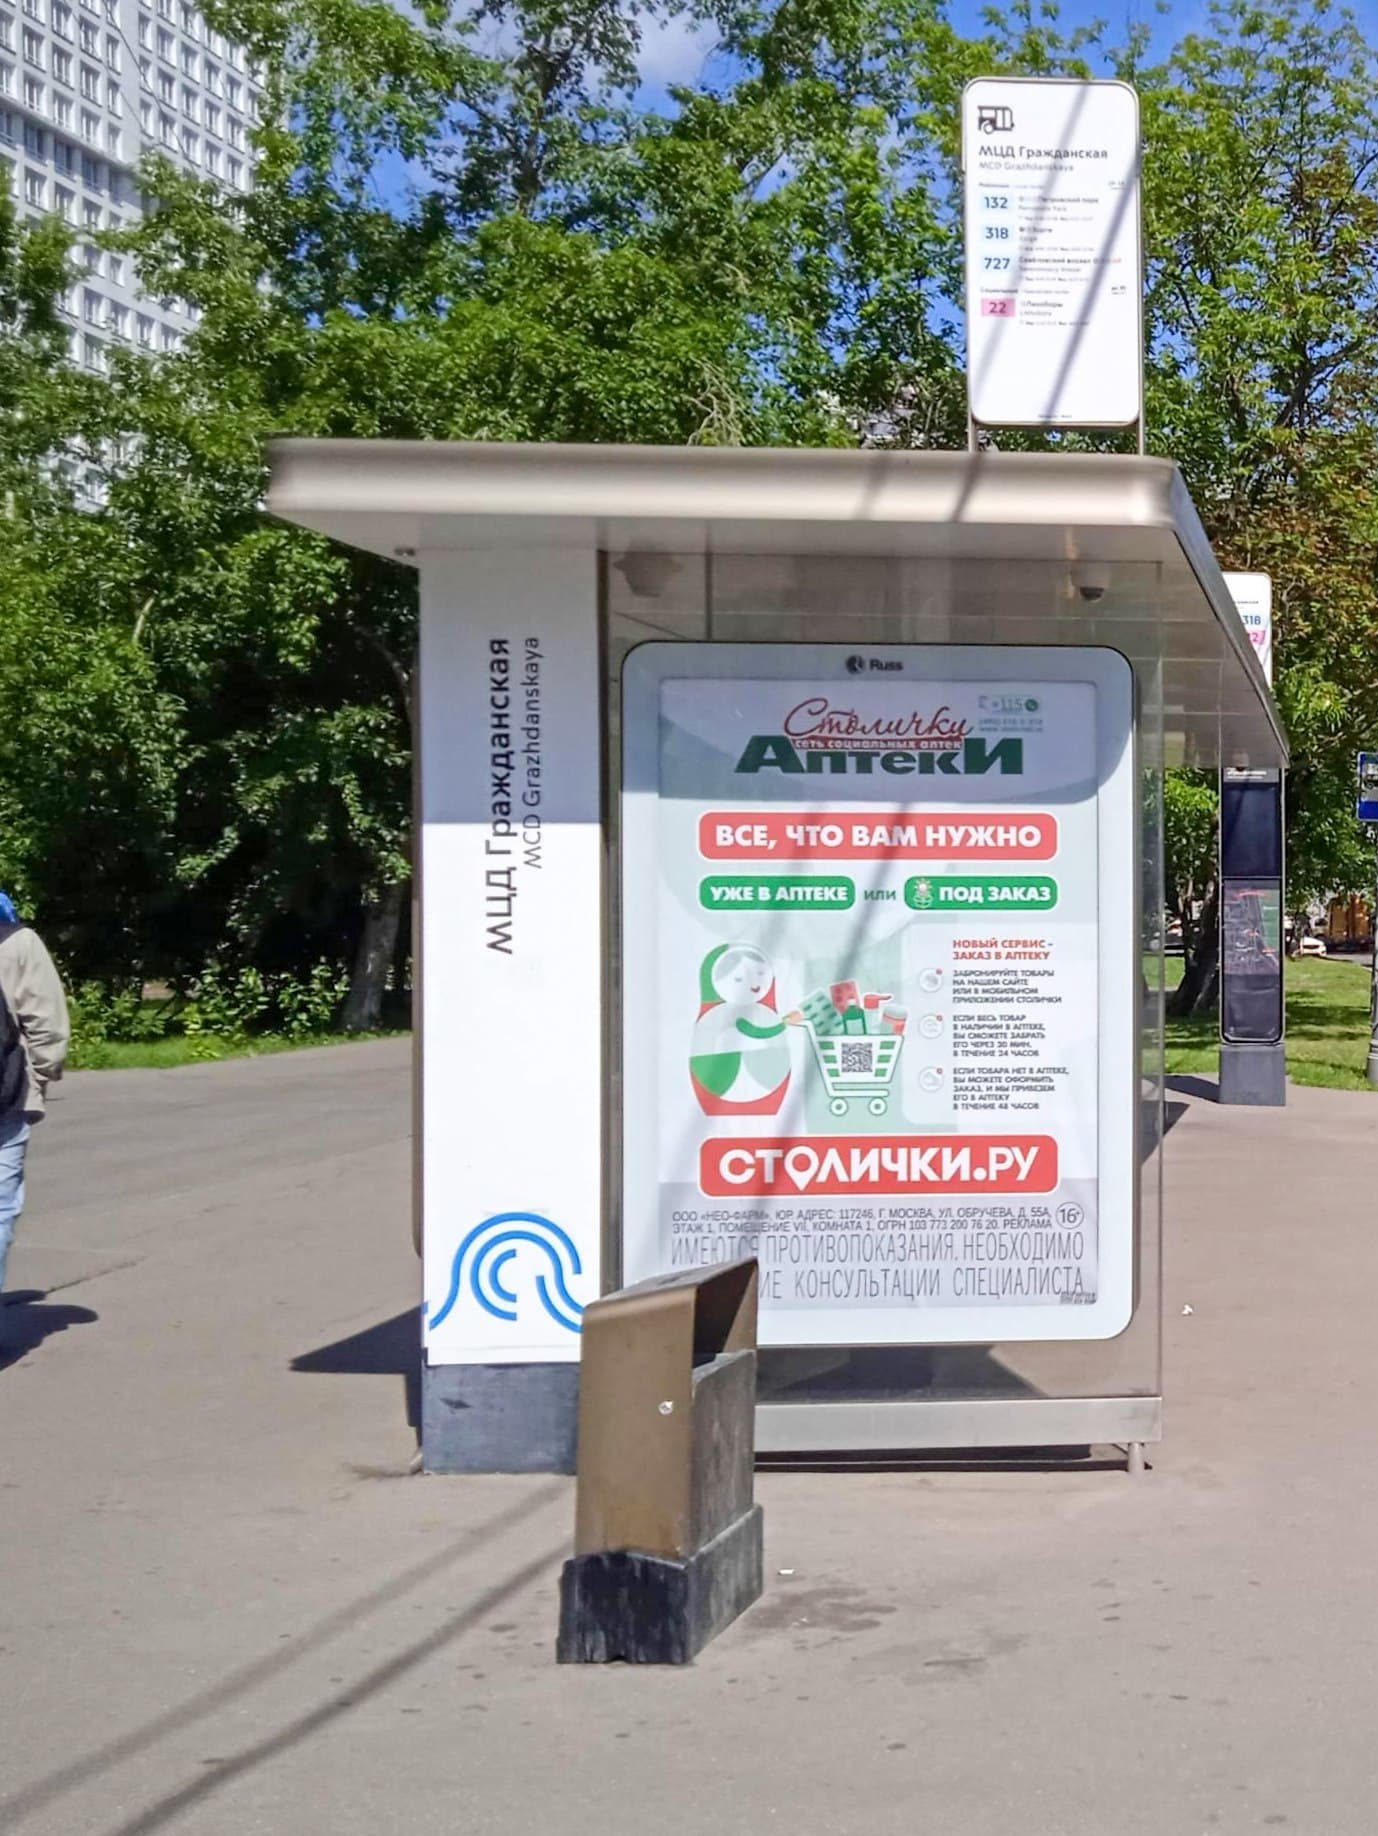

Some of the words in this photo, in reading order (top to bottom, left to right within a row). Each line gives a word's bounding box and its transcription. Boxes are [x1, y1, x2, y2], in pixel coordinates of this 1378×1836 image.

[978, 145, 1015, 158] МЦД
[1019, 146, 1108, 160] Гражданская
[978, 161, 1002, 170] MCD
[984, 196, 1008, 209] 132
[985, 227, 1009, 239] 318
[984, 257, 1010, 270] 727
[989, 302, 1007, 314] 22
[869, 659, 903, 671] Russ
[521, 637, 544, 806] Grazhdanskaya
[784, 697, 975, 737] Столички
[485, 638, 517, 856] Гражданская
[795, 740, 825, 748] сеть
[827, 740, 916, 750] социальных
[920, 740, 963, 749] аптек
[523, 814, 542, 868] MCD
[714, 824, 776, 850] ВСЕ,
[785, 824, 843, 848] ЧТО
[852, 824, 917, 848] ВАМ
[926, 824, 1041, 848] НУЖНО
[710, 886, 756, 902] УЖЕ
[760, 886, 771, 902] В
[778, 886, 848, 902] АПТЕКЕ
[939, 886, 984, 903] ПОД
[988, 886, 1051, 902] ЗАКАЗ
[486, 866, 517, 954] МЦД
[953, 937, 998, 948] НОВЫЙ
[1001, 939, 1046, 948] СЕРВИС
[953, 951, 991, 960] ЗАКАЗ
[995, 951, 1002, 960] В
[1005, 951, 1050, 960] АПТЕКУ
[953, 968, 1018, 977] ЗАБРОНИРУЙТЕ
[1002, 976, 1028, 986] САЙТЕ
[719, 1145, 1040, 1191] СТОЛИЧКИ.РУ
[672, 1211, 698, 1222] ООО
[1059, 1208, 1081, 1224] 16+
[673, 1223, 703, 1234] ЭТАЖ
[719, 1221, 789, 1234] ПОМЕЩЕНИЕ
[813, 1221, 862, 1232] КОМНАТА
[877, 1220, 906, 1231] ОГРН
[909, 1220, 927, 1230] 103
[930, 1219, 947, 1230] 773
[950, 1219, 968, 1230] 200
[971, 1219, 983, 1229] 76
[1003, 1218, 1052, 1229] РЕКЛАМА
[672, 1235, 760, 1265] ИМЕЮТСЯ
[963, 1231, 1084, 1263] НЕОБХОДИМО
[795, 1268, 940, 1299] КОНСУЛЬТАЦИИ
[953, 1266, 1084, 1299] СПЕЦИАЛИСТА
